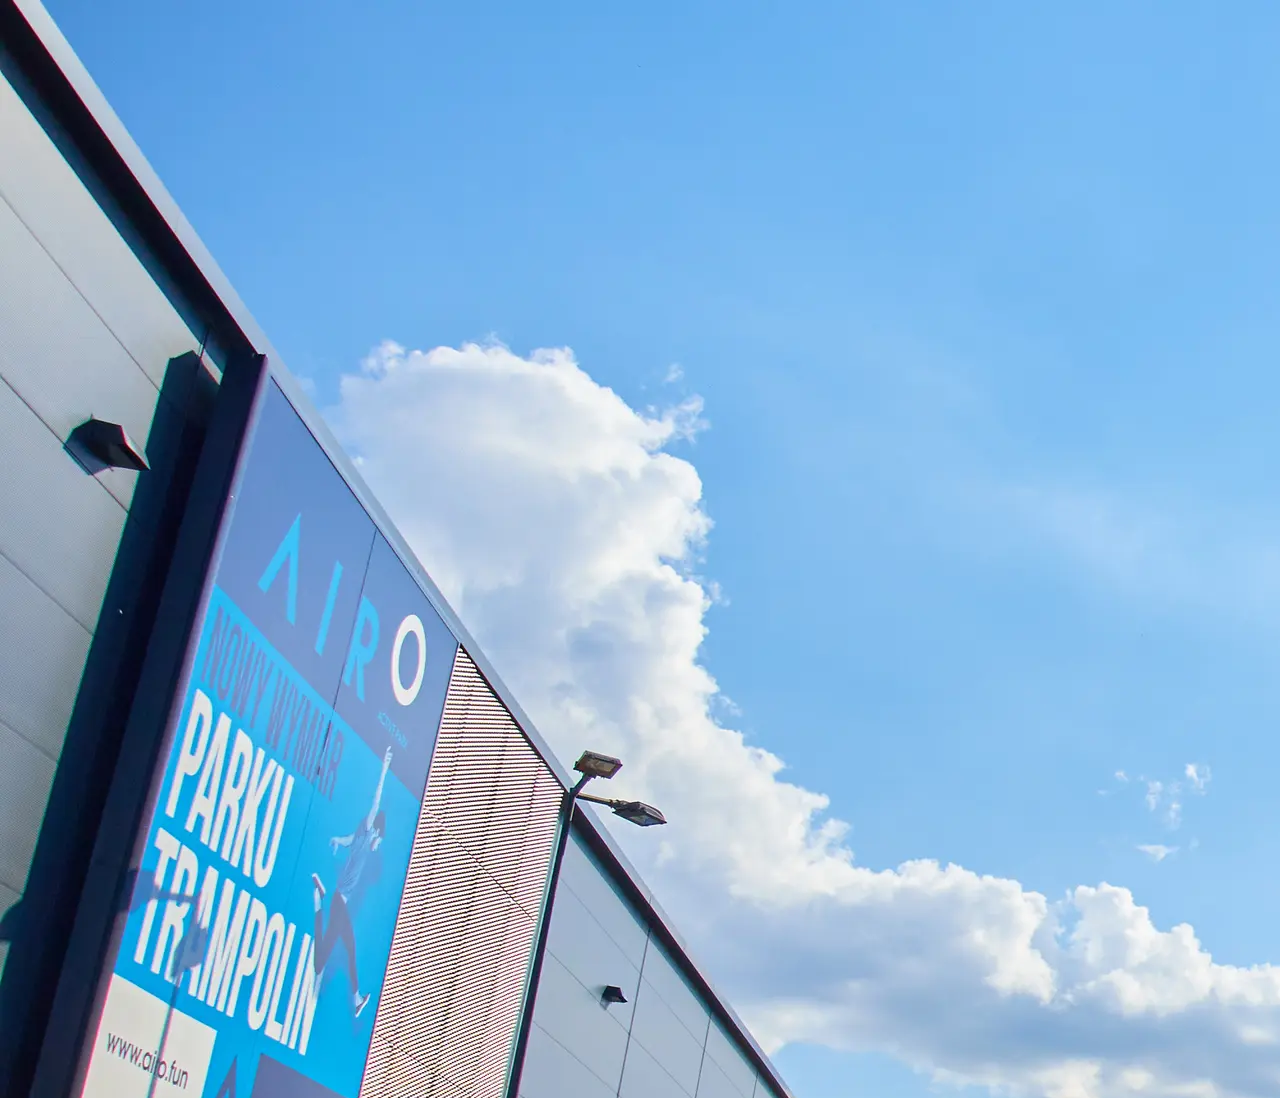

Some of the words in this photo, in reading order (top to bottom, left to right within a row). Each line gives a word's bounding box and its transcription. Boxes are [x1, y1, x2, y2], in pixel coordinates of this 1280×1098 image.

[165, 688, 295, 888] PARKU
[200, 603, 273, 730] NOWY
[266, 662, 344, 802] WYMIAR
[134, 827, 319, 1056] TRAMPOLIN
[107, 1033, 189, 1089] www.airo.fun
